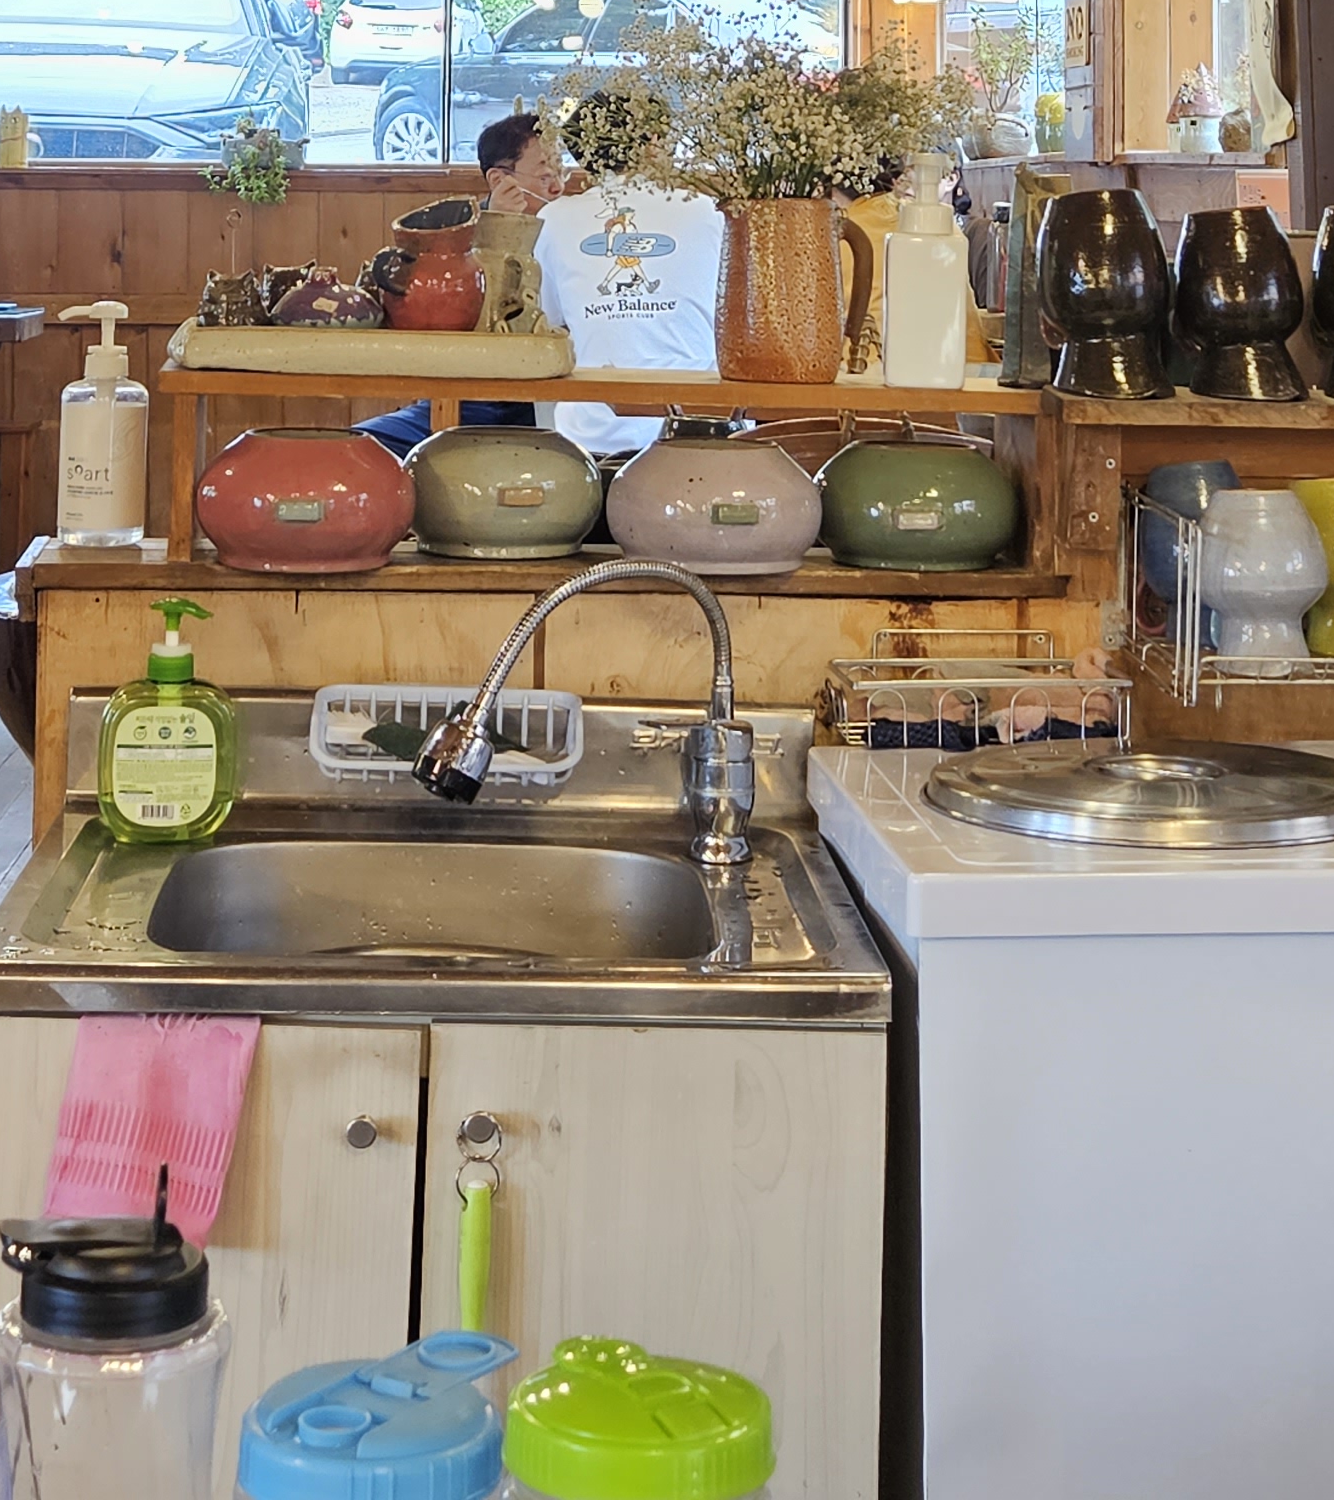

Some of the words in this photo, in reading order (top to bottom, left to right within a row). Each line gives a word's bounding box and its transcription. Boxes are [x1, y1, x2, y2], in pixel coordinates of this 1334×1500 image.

[1066, 6, 1084, 41] NO
[584, 303, 615, 319] New
[618, 299, 677, 312] Balance
[608, 312, 634, 320] SPORTS
